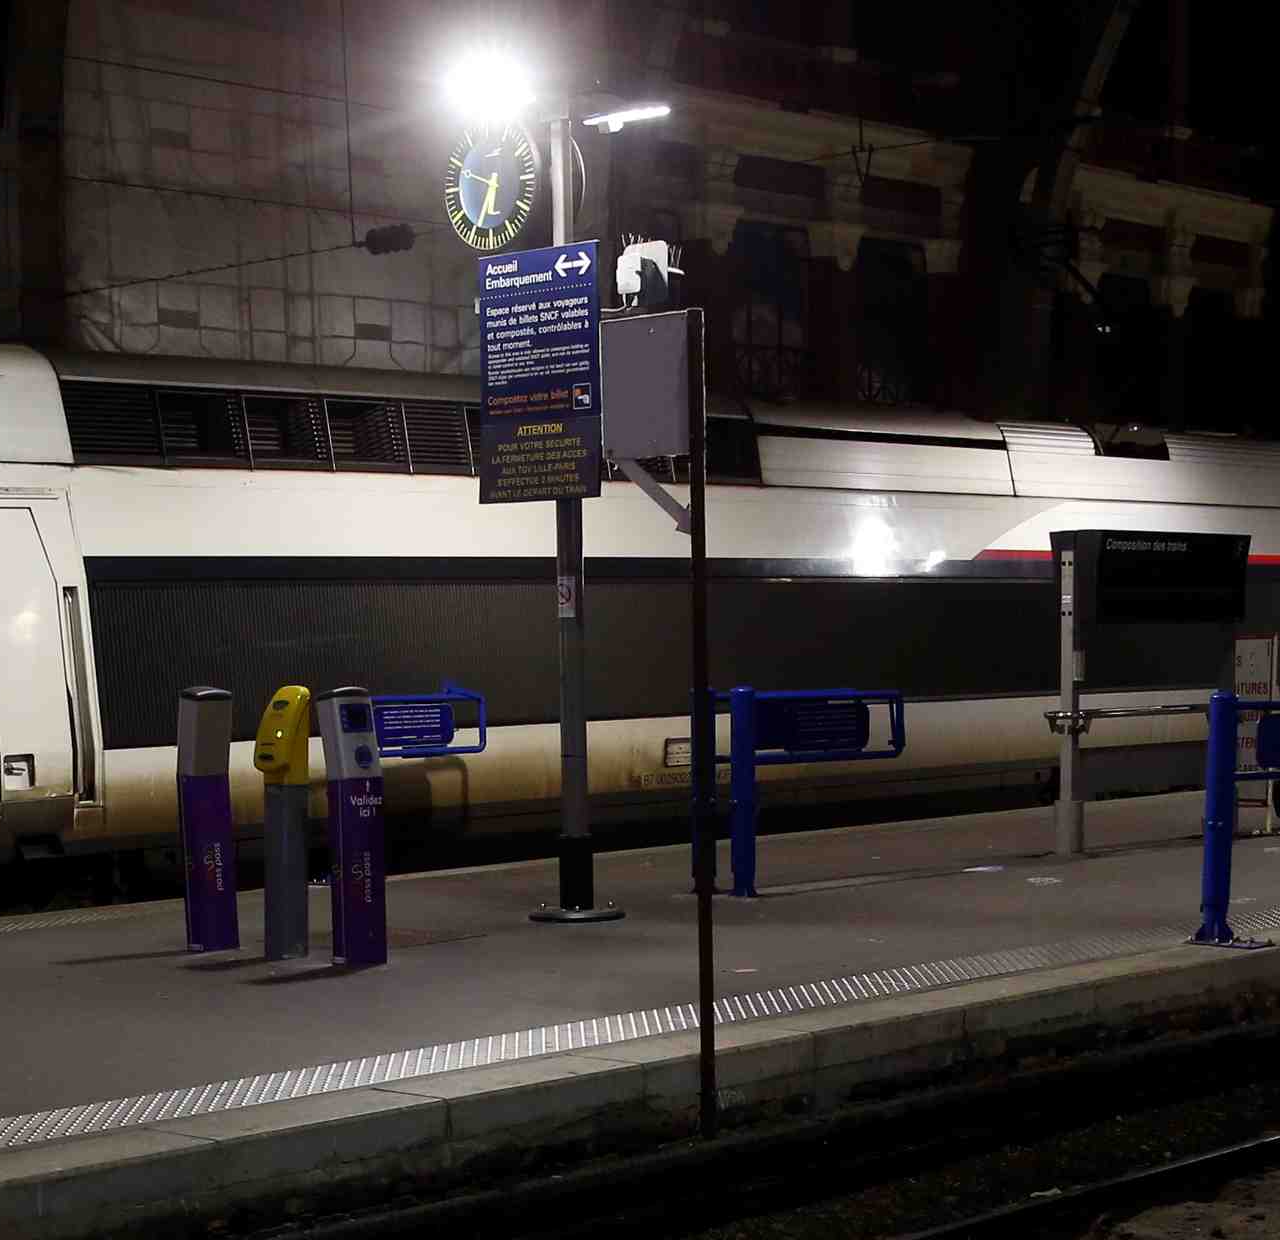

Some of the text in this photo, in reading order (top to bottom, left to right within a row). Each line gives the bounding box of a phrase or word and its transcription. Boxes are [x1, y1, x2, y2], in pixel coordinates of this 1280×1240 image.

[486, 260, 518, 275] Accueil
[485, 270, 553, 290] Embarquement
[486, 296, 589, 317] Espace réservé aux voyageurs
[486, 308, 589, 328] munis de billets SNCF valables
[487, 332, 494, 340] et
[538, 320, 582, 334] contrôlables
[487, 340, 532, 352] tout moment.
[516, 423, 564, 437] ATTENTION
[350, 793, 384, 807] Validez
